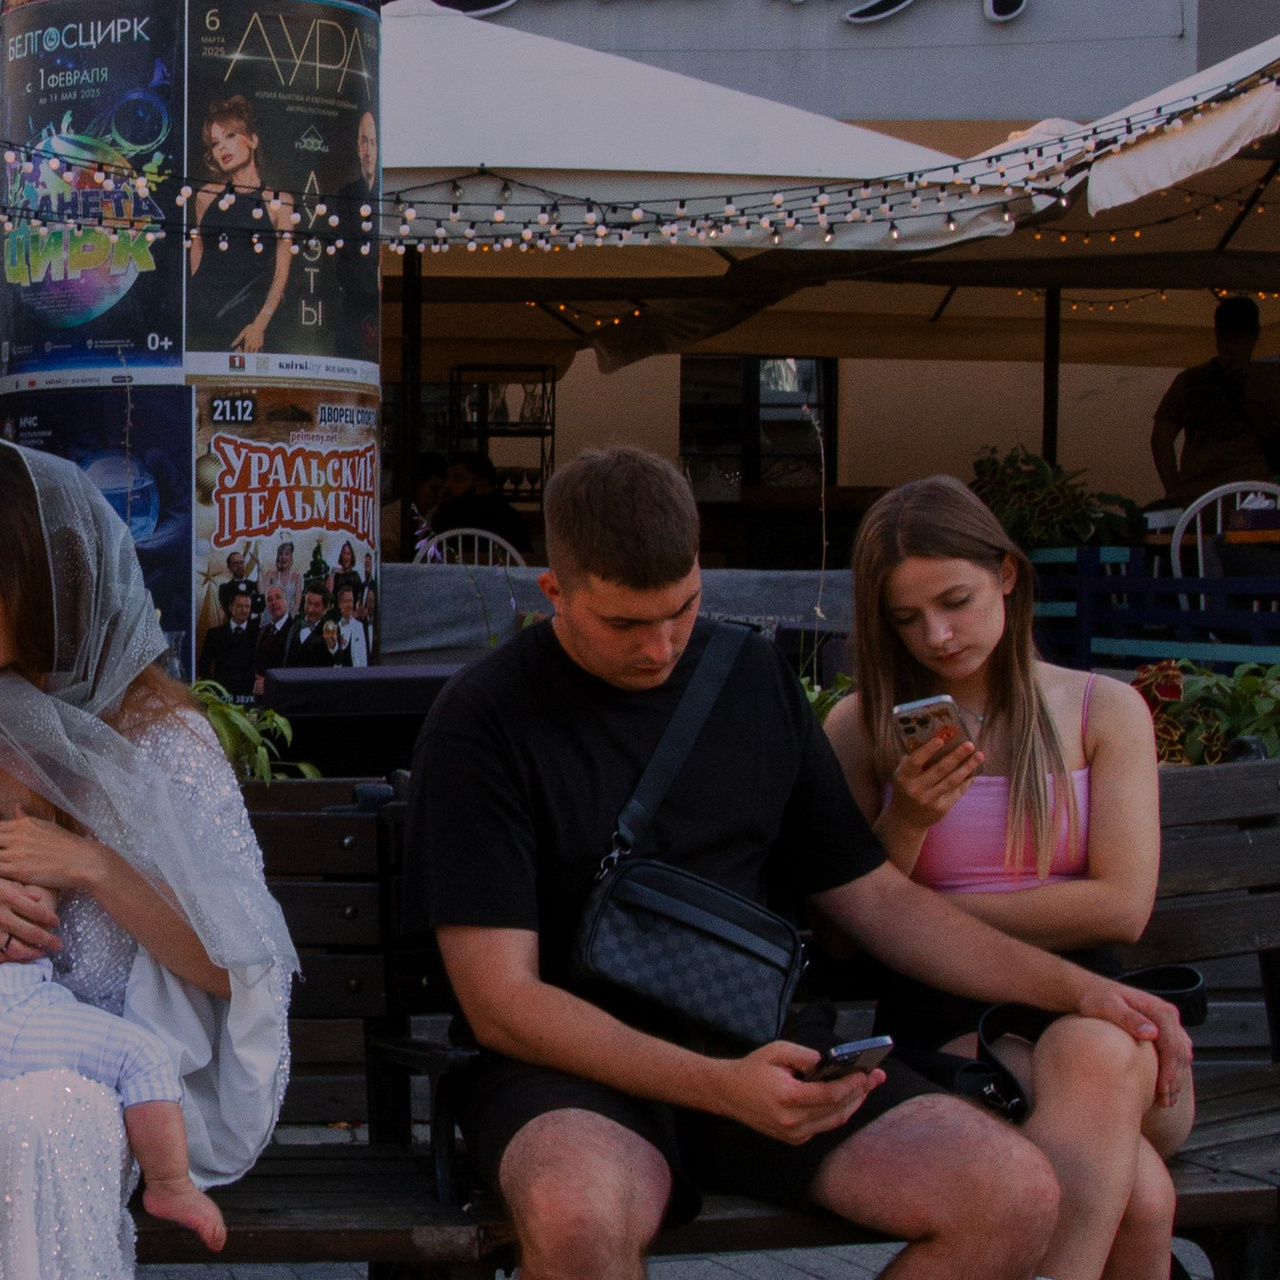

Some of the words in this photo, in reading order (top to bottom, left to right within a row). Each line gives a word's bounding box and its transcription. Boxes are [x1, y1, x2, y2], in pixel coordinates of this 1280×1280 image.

[205, 9, 220, 31] 6
[8, 17, 150, 62] БЕЛГОСЦИРК
[201, 36, 225, 44] МАРТА
[202, 46, 225, 56] 2025
[39, 68, 45, 90] 1
[47, 67, 109, 89] ФЕВРАЛЯ
[60, 91, 78, 101] МАЯ
[80, 88, 101, 99] 2025
[7, 187, 166, 221] АНЕТА
[4, 223, 161, 287] ЦИРК
[147, 333, 173, 351] 0+
[213, 399, 253, 421] 21.12
[320, 406, 355, 428] ДВОРЕЦ
[291, 430, 337, 443] pelmeny.net
[221, 442, 374, 492] УРАЛЬСКИЕ
[220, 489, 374, 542] ПЕЛЬМЕНИ
